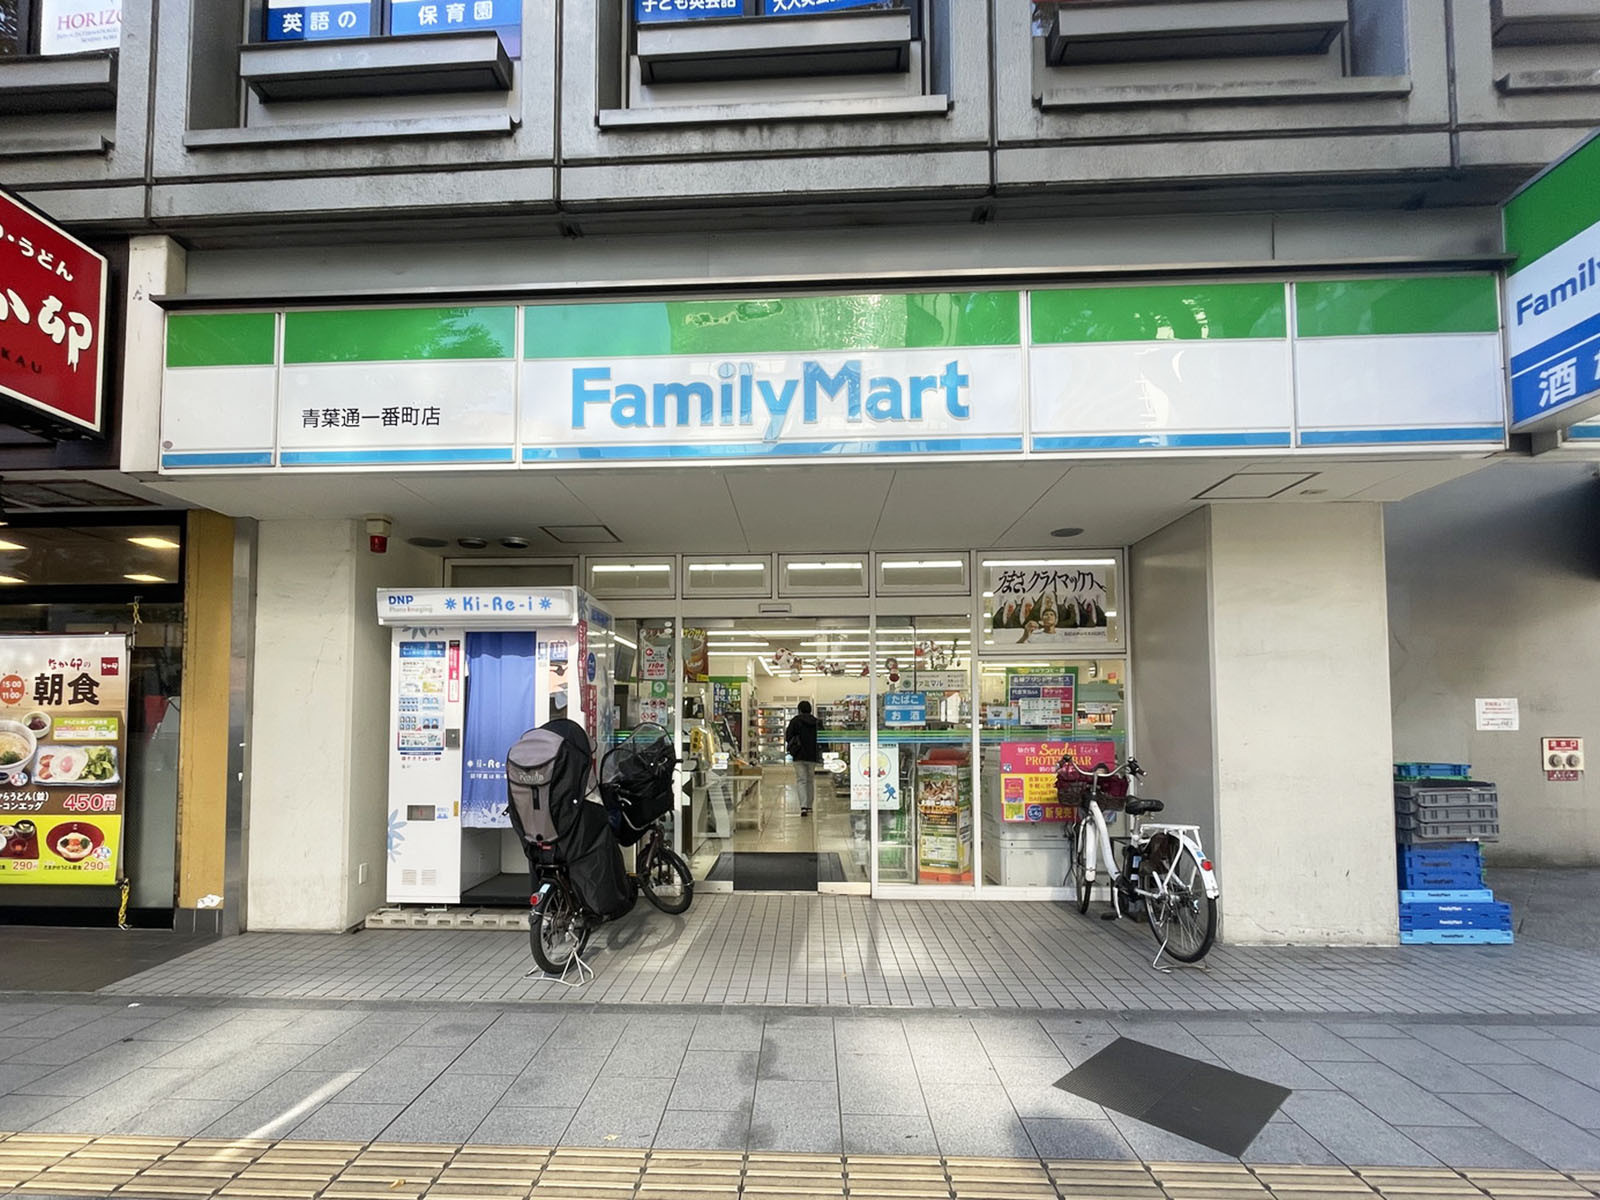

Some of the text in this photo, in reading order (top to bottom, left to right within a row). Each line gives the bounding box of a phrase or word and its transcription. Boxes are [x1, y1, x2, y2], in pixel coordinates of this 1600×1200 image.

[282, 1, 492, 33] 英語の 保育園
[1539, 357, 1577, 408] 酒
[571, 359, 969, 443] FamilyMart
[301, 406, 441, 428] 青葉通一番町店
[388, 595, 414, 605] DNP
[462, 596, 534, 611] Ki-Re-i
[33, 673, 100, 706] 朝食
[891, 694, 919, 704] たばこ
[1039, 743, 1077, 755] Sendai
[0, 802, 44, 811] コンエッグ
